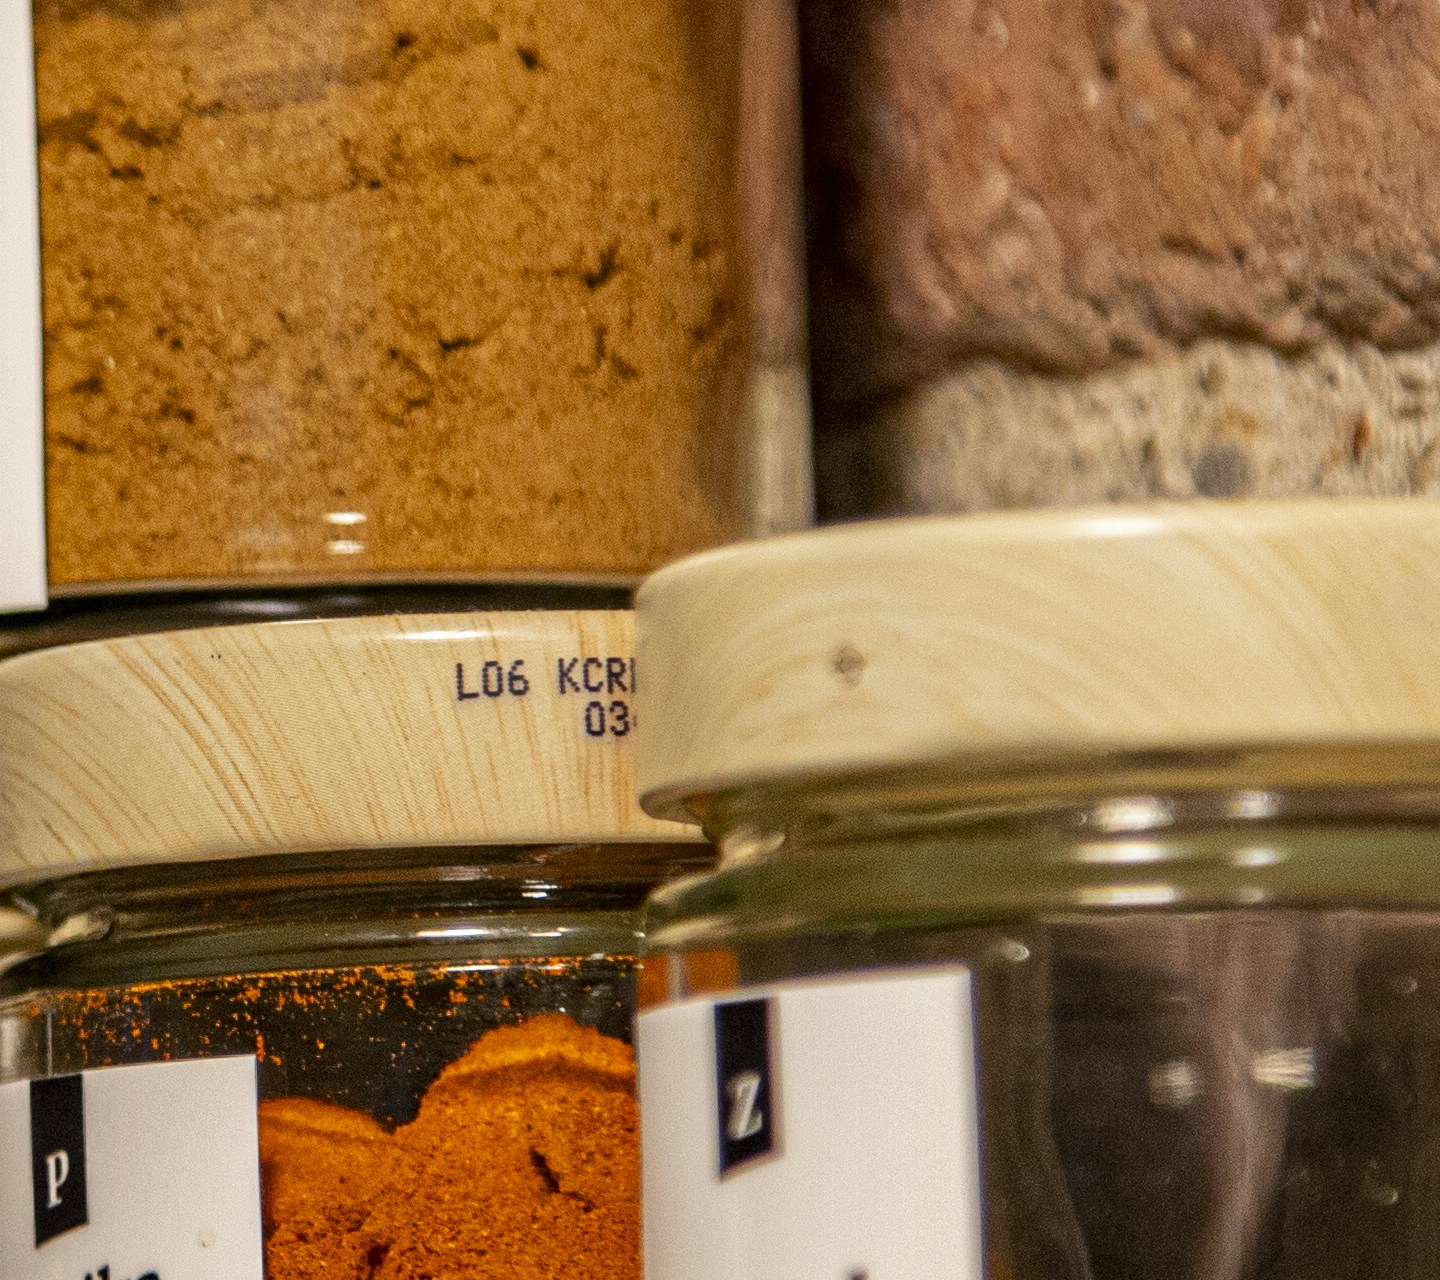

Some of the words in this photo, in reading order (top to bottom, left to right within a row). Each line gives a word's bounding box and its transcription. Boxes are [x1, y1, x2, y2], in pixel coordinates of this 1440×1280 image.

[456, 660, 530, 701] L06
[557, 657, 637, 695] KCR
[584, 700, 638, 737] 03
[726, 1072, 764, 1141] Z
[46, 1147, 70, 1209] P
